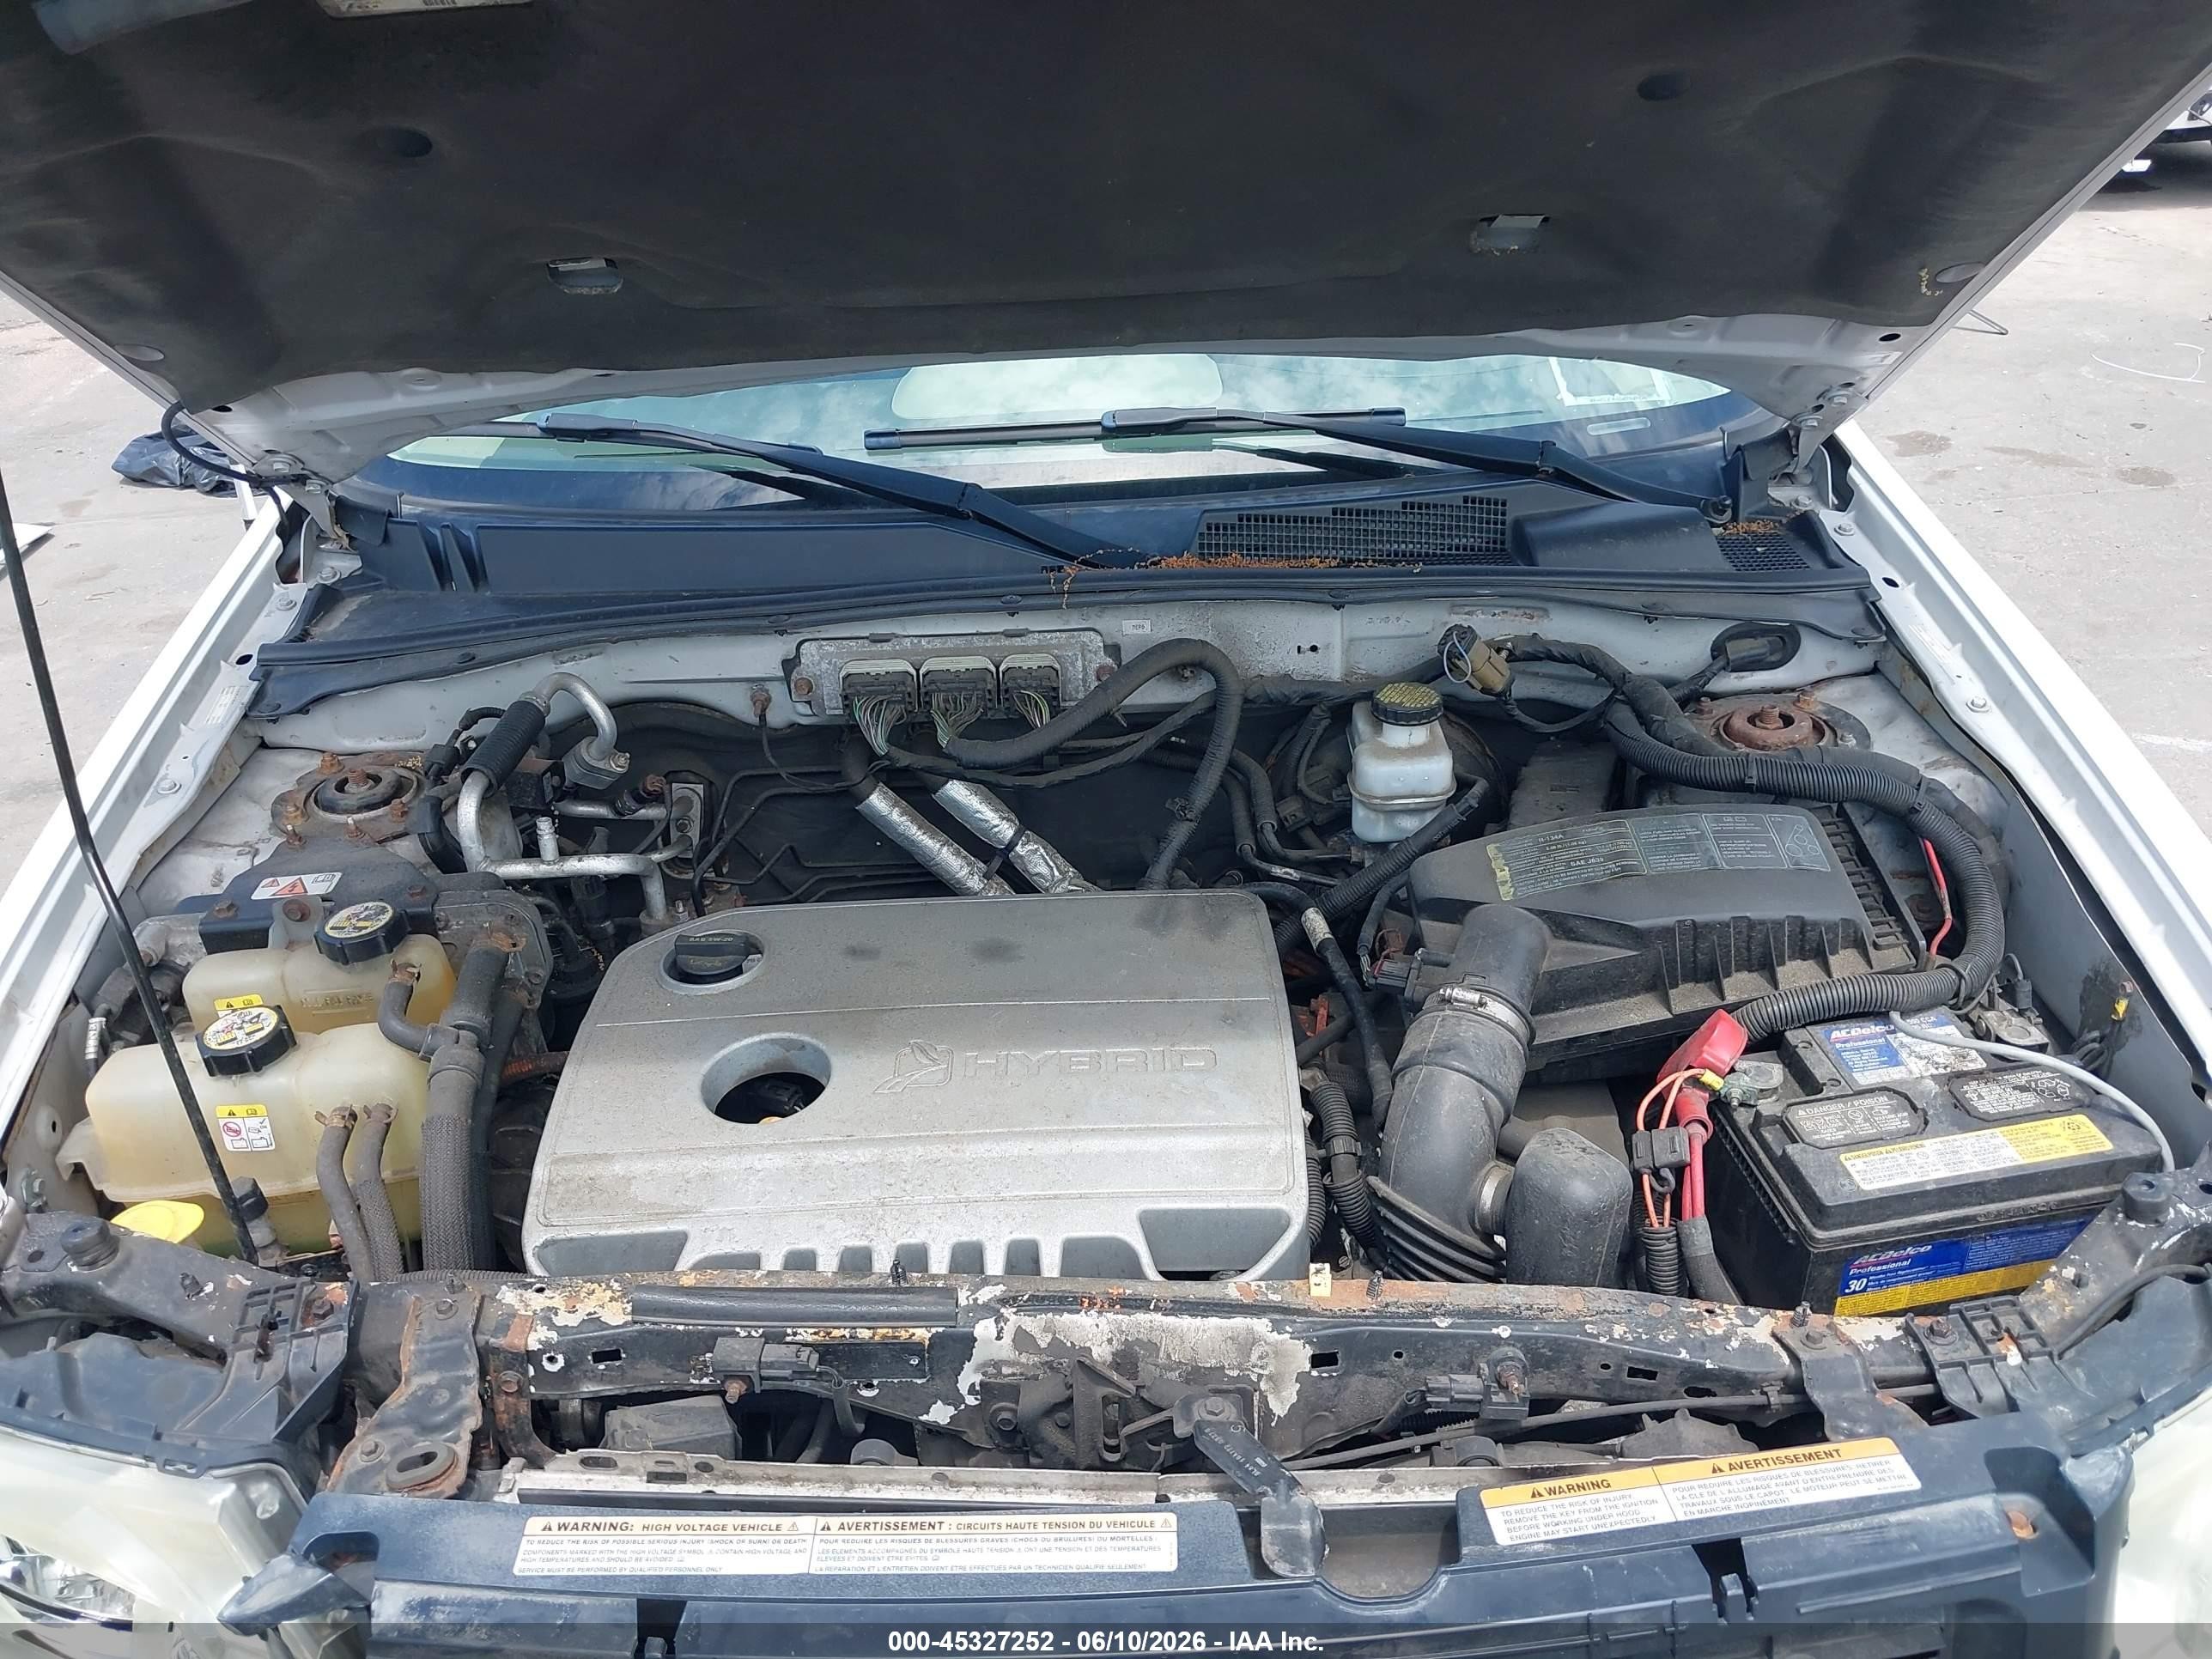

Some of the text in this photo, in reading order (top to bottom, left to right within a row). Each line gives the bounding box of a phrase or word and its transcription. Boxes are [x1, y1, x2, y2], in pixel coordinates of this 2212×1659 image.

[1831, 1024, 1896, 1038] ACDelco
[1836, 1037, 1887, 1049] Professional
[963, 1046, 1218, 1078] HYBRID
[1806, 1103, 1844, 1115] DANGER
[1853, 1096, 1888, 1107] POISON
[1854, 1245, 1933, 1264] ACDelco
[1849, 1259, 1911, 1275] Professional
[1844, 1278, 1868, 1293] 30
[1728, 1449, 1843, 1472] AVERTISSEMENT
[1544, 1479, 1611, 1497] WARNING
[1504, 1516, 1539, 1526] REMOVE
[1578, 1506, 1602, 1515] FROM
[1622, 1499, 1659, 1508] IGNITION
[1515, 1506, 1547, 1516] REDUCE
[557, 1522, 783, 1532] WARNING: HIGH VOLTAGE VEHICLE
[838, 1522, 945, 1532] AVERTISSEMENT
[1006, 1522, 1038, 1530] HAUTE
[1042, 1522, 1085, 1530] TENSION
[1106, 1520, 1156, 1528] VEHICULE
[1507, 1513, 1614, 1534] BEFORE WORKING UNDER
[1510, 1532, 1540, 1541] ENGINE
[1563, 1525, 1589, 1534] START
